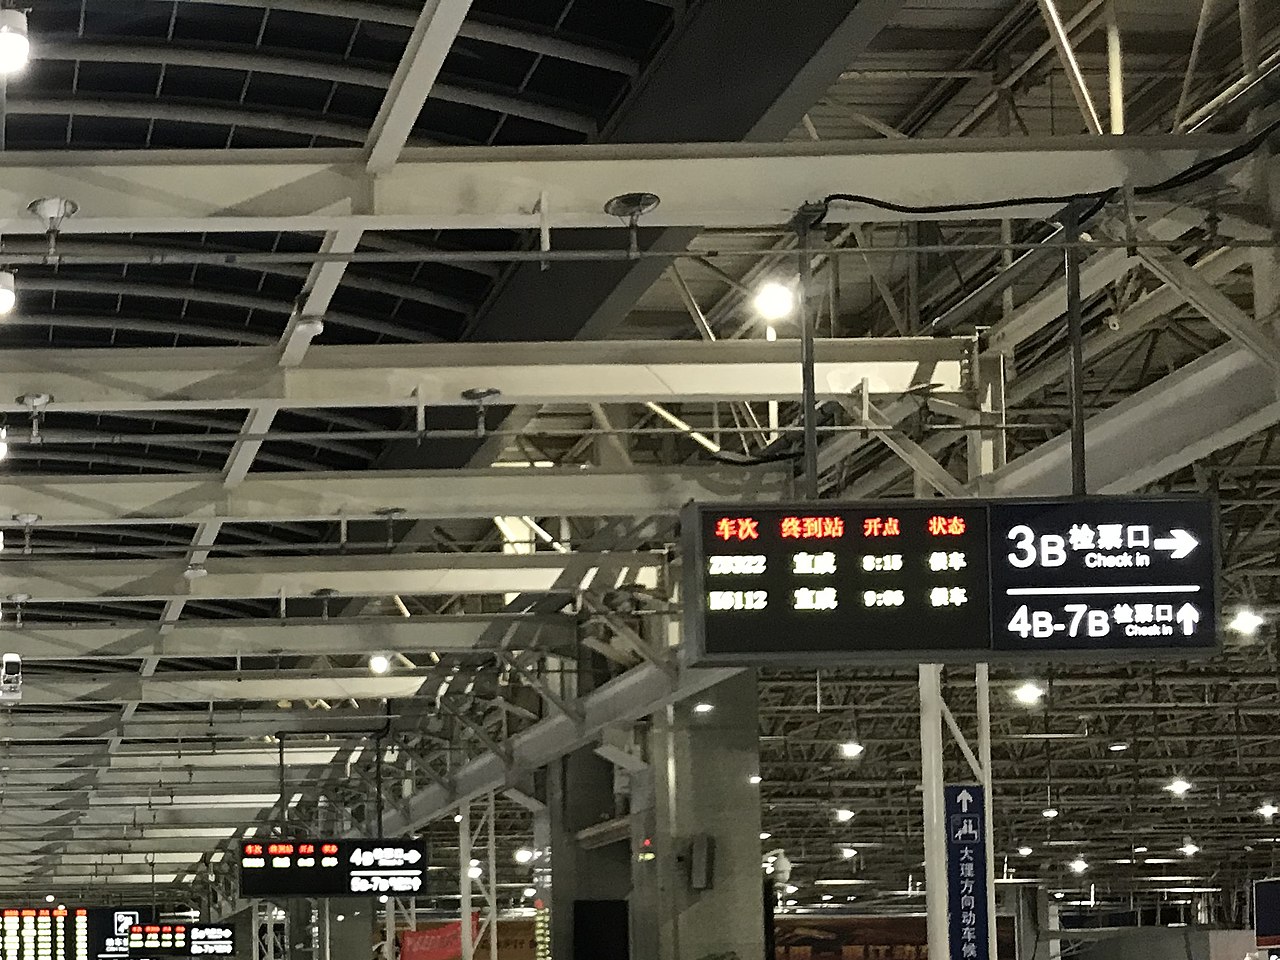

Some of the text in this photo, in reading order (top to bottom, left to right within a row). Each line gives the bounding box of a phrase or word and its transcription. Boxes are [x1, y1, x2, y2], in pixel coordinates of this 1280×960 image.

[716, 516, 966, 540] 车次 终到站 开点 状态
[1007, 523, 1150, 569] 3B 检票口
[1084, 552, 1134, 568] Check
[1007, 603, 1110, 639] 4B-7B
